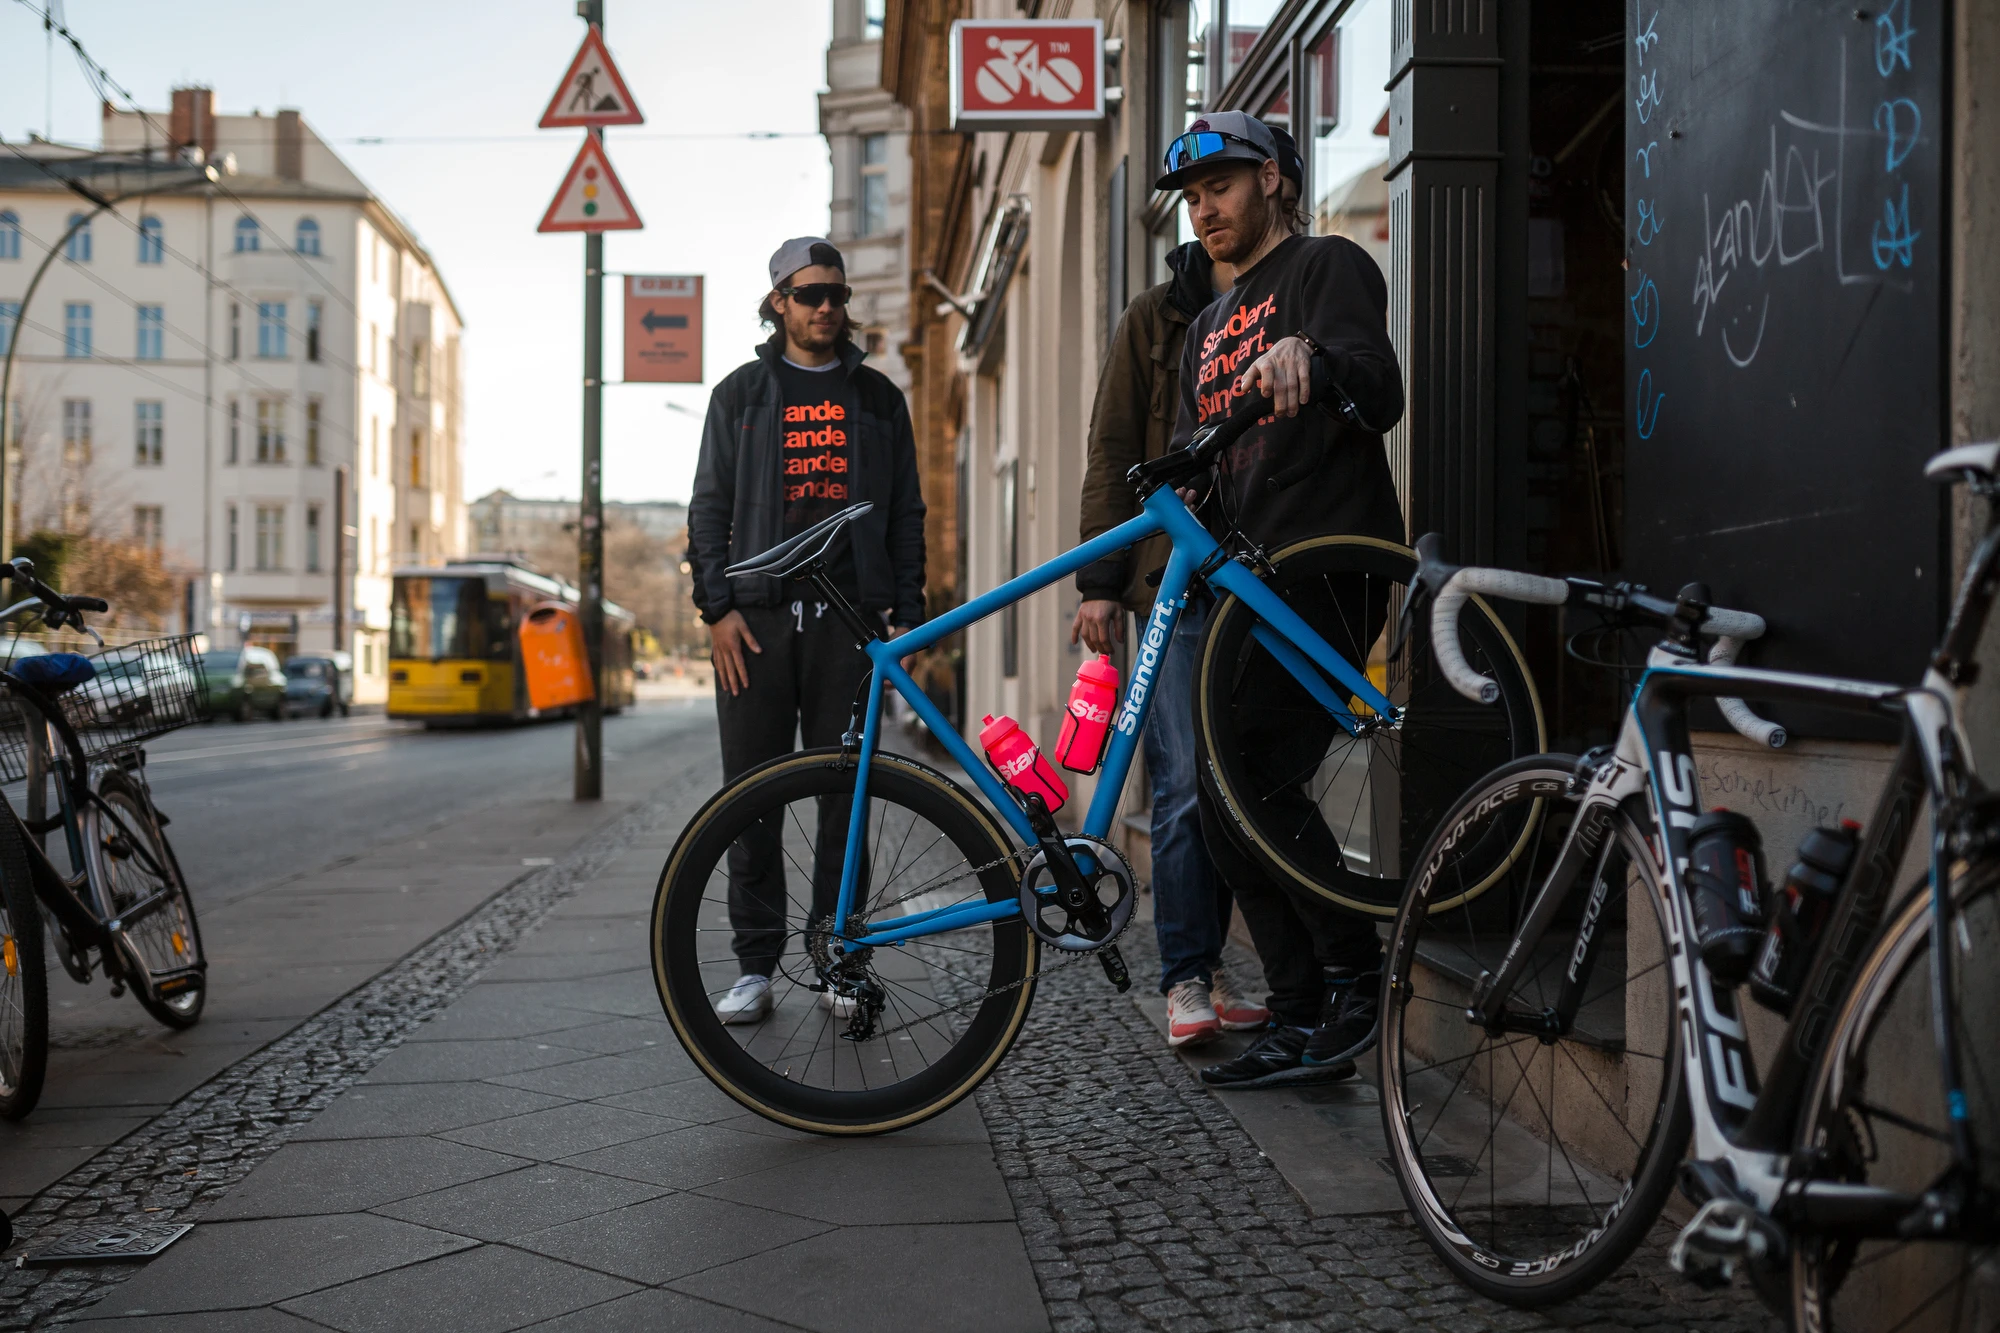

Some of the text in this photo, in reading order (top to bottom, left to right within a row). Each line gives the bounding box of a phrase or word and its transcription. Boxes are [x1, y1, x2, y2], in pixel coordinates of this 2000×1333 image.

[1050, 41, 1071, 54] TM
[783, 400, 846, 423] ande
[1117, 598, 1176, 736] Standert.
[1772, 733, 1786, 745] 3T
[1597, 757, 1628, 791] 3T
[1419, 783, 1520, 898] DURA-ACE
[1530, 781, 1560, 791] C35
[1567, 878, 1609, 984] FOCUS
[1471, 1179, 1634, 1276] DURA-ACE C35
